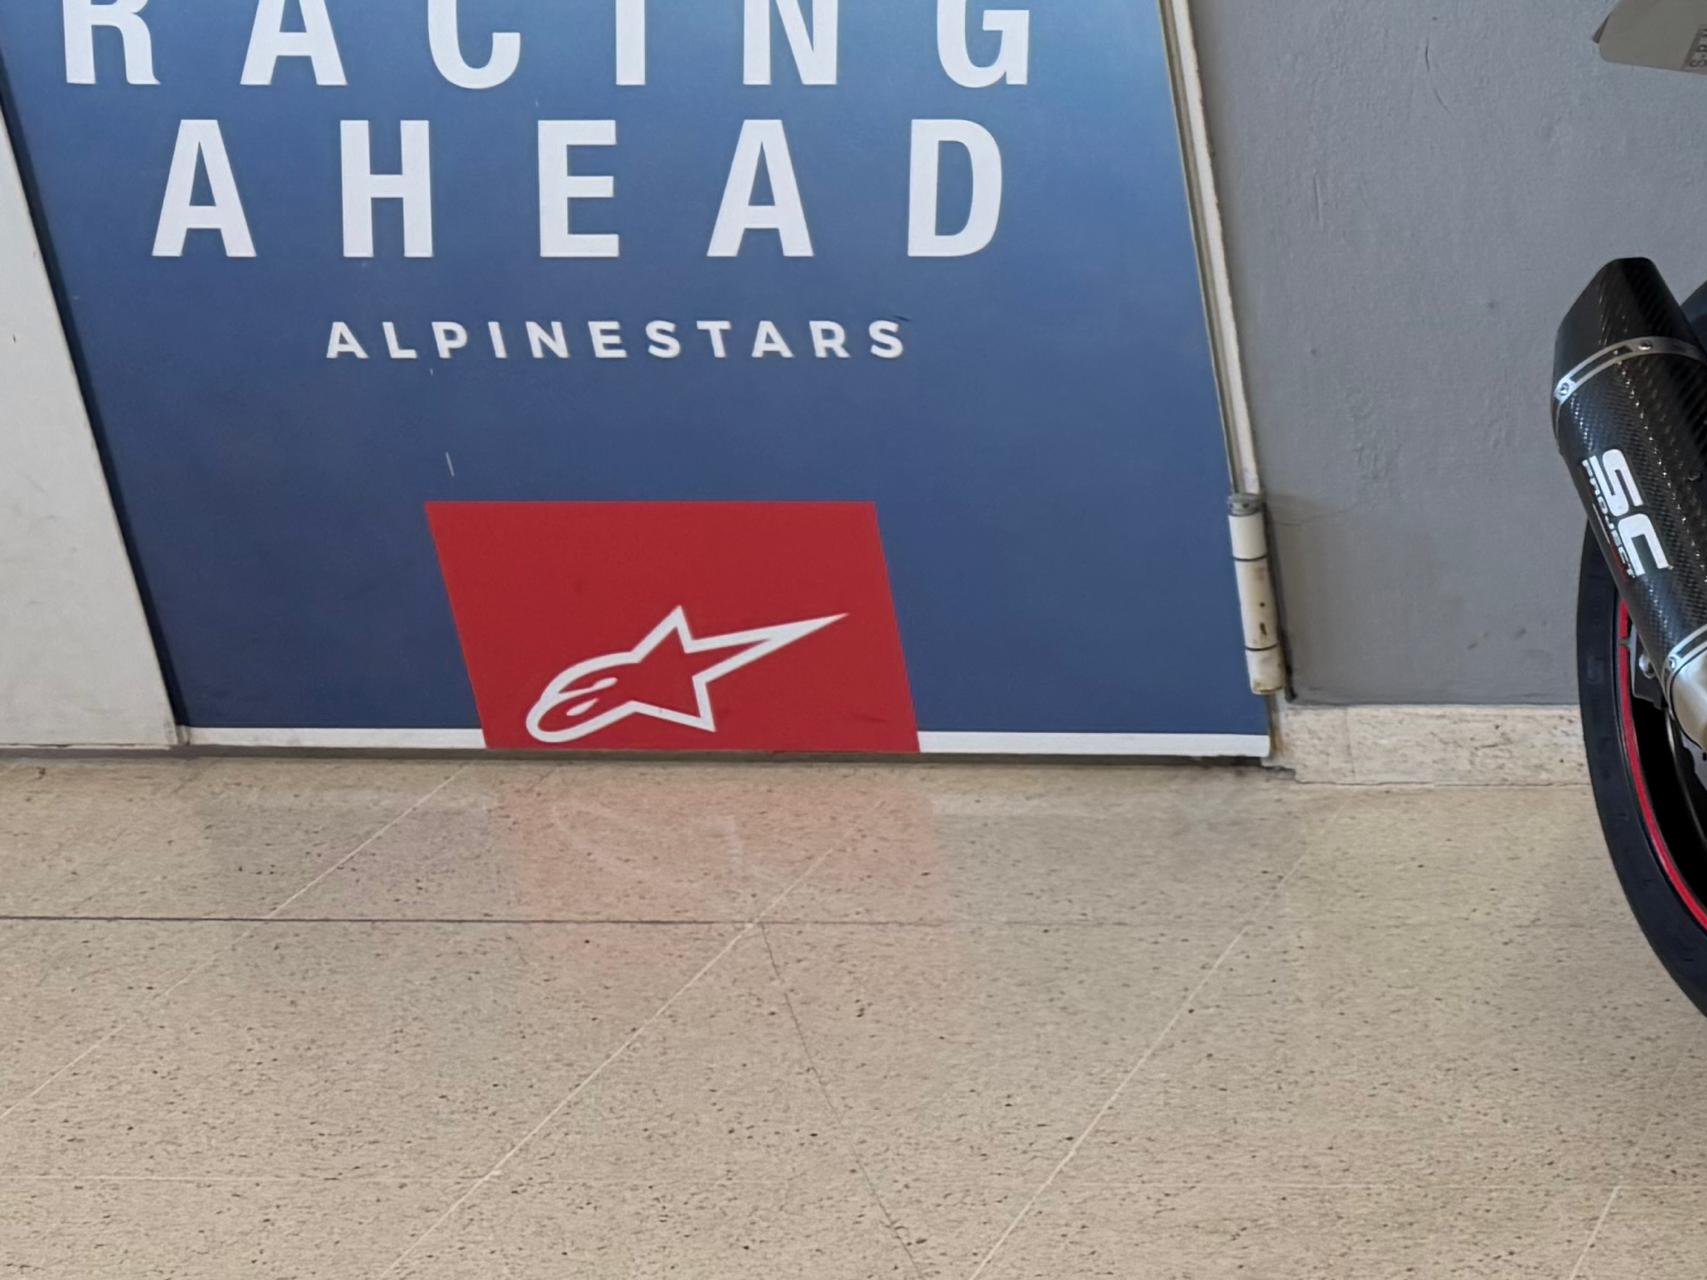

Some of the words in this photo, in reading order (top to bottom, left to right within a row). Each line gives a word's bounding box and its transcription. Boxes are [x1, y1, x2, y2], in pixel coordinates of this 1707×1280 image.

[152, 119, 1003, 259] AHEAD
[326, 320, 905, 361] ALPINESTARS
[1589, 448, 1670, 577] SC
